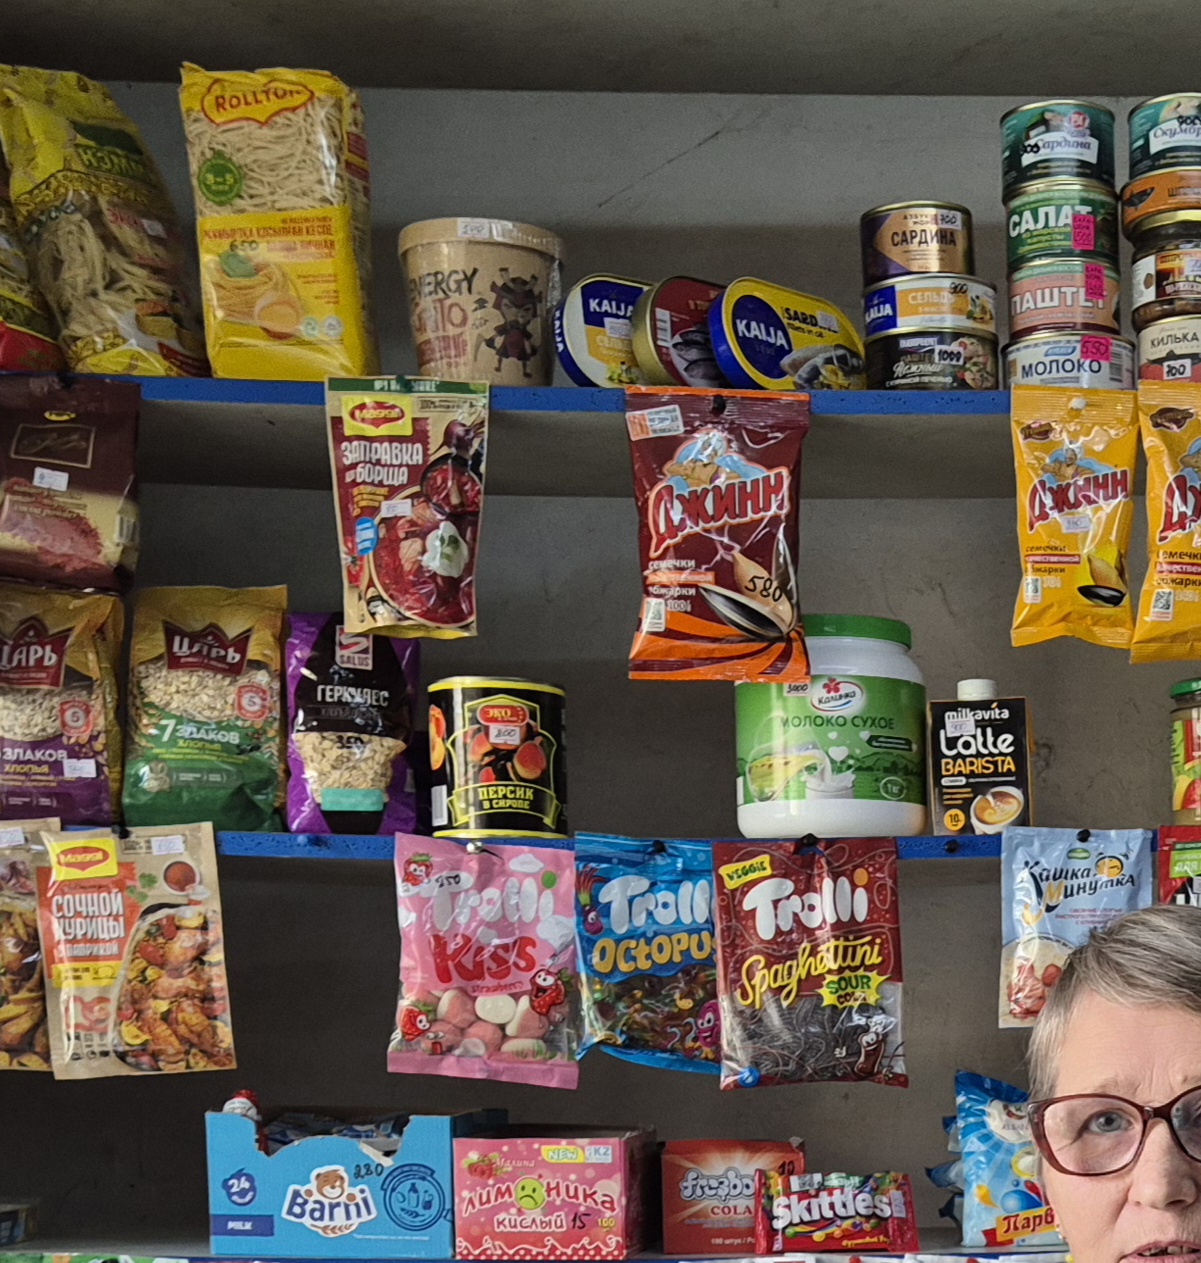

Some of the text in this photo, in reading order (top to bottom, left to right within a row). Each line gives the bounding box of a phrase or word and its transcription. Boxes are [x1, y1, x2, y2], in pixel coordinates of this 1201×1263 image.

[890, 229, 957, 249] САРДИНА
[864, 302, 894, 323] KAIJA
[735, 318, 791, 350] KAIJA
[1150, 331, 1201, 349] КИЛЬКА
[1020, 357, 1103, 379] МОЛОКО
[341, 440, 424, 466] ЗАПРАВКА
[652, 472, 789, 542] ДЖИНН
[1027, 468, 1129, 527] ДЖИНН
[744, 576, 783, 603] 580
[172, 635, 241, 665] ЦАРЬ
[850, 717, 896, 730] СУХОЕ
[940, 731, 1016, 757] Latte
[940, 758, 1016, 775] BARISTA
[477, 785, 535, 802] ПЕРСИК
[52, 890, 125, 919] СОЧНОЙ
[742, 876, 869, 941] Trolli
[737, 936, 883, 1010] Spaghettini
[825, 974, 872, 993] SOUR
[546, 1148, 578, 1162] NEW
[286, 1189, 374, 1228] Barni
[710, 1205, 752, 1216] COLA
[494, 1214, 566, 1231] кислый
